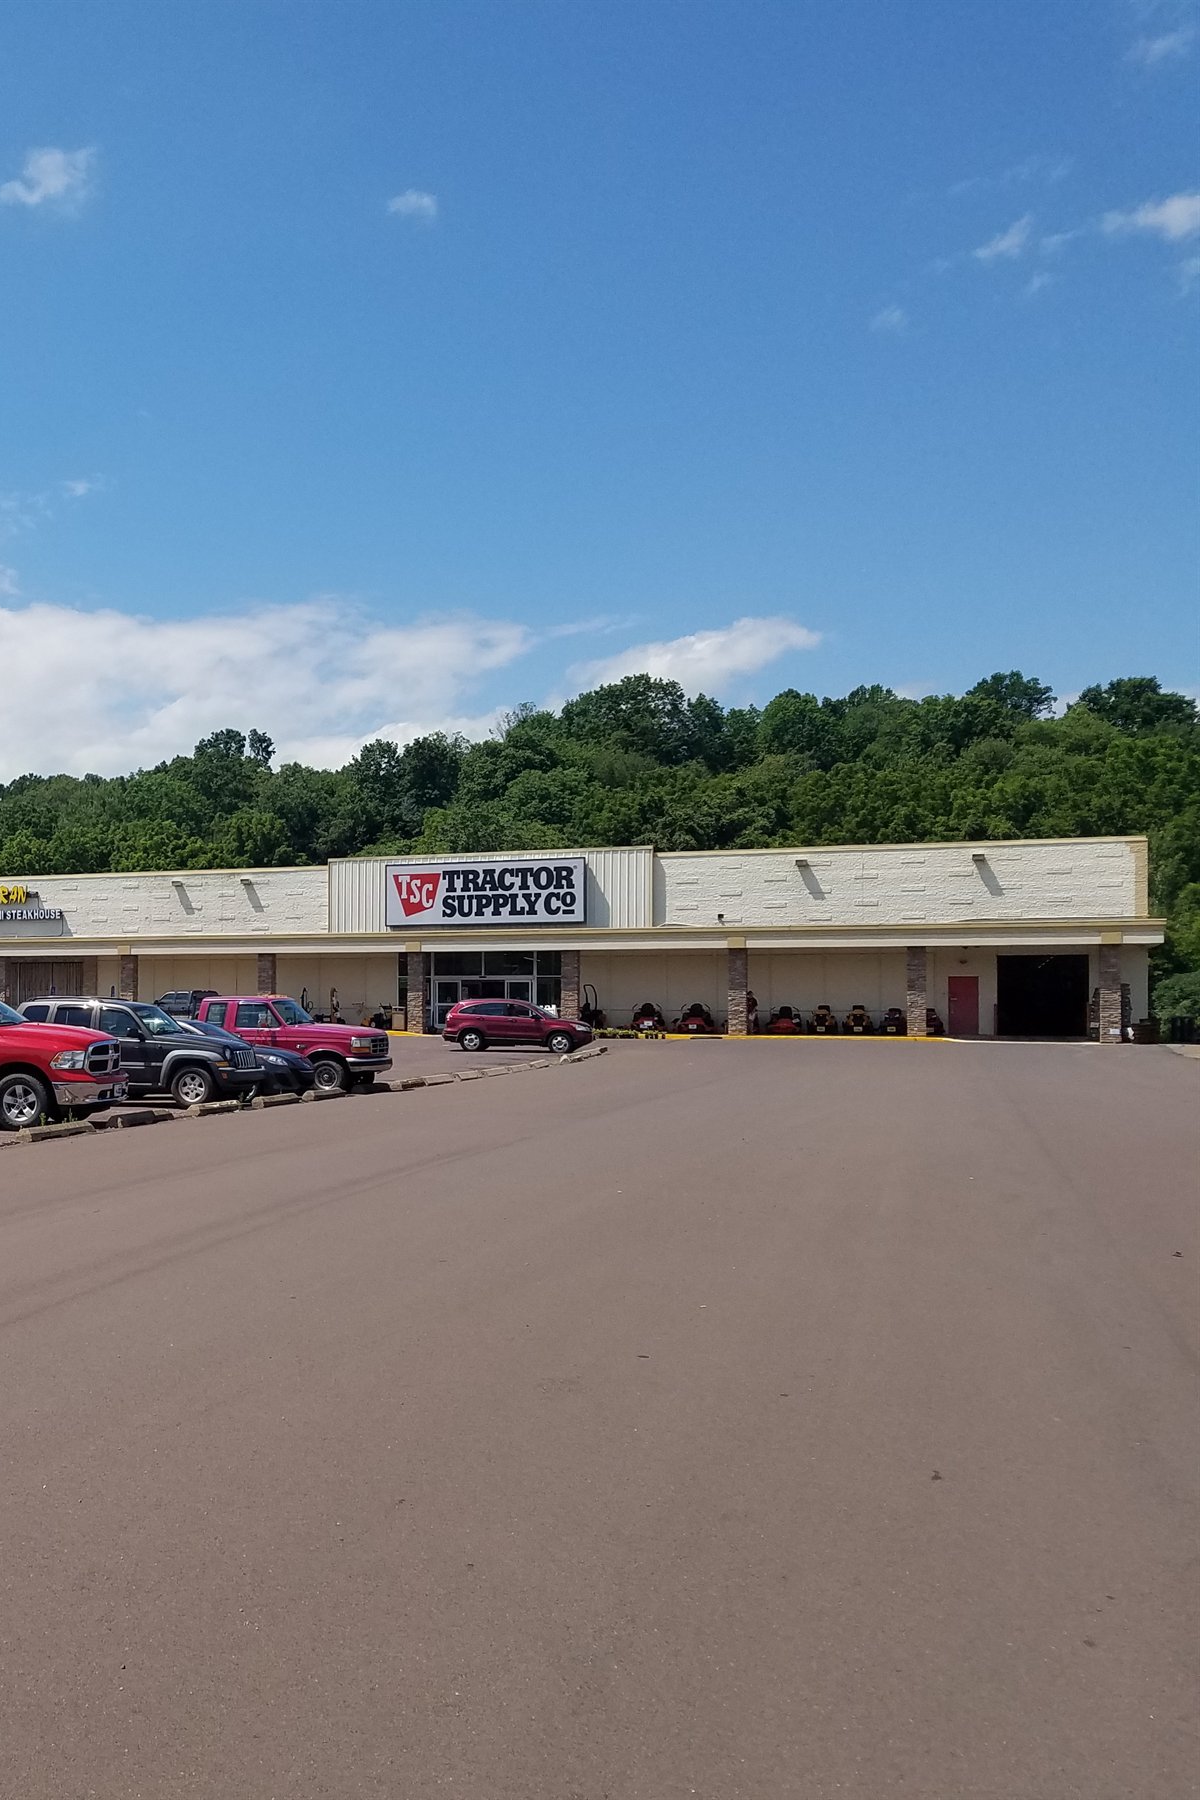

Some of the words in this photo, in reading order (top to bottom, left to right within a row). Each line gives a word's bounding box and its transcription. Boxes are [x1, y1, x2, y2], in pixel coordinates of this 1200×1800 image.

[398, 875, 433, 908] TSC
[442, 866, 575, 893] TRACTOR
[6, 909, 61, 920] STEAKHOUSE
[442, 893, 541, 918] SUPPLY
